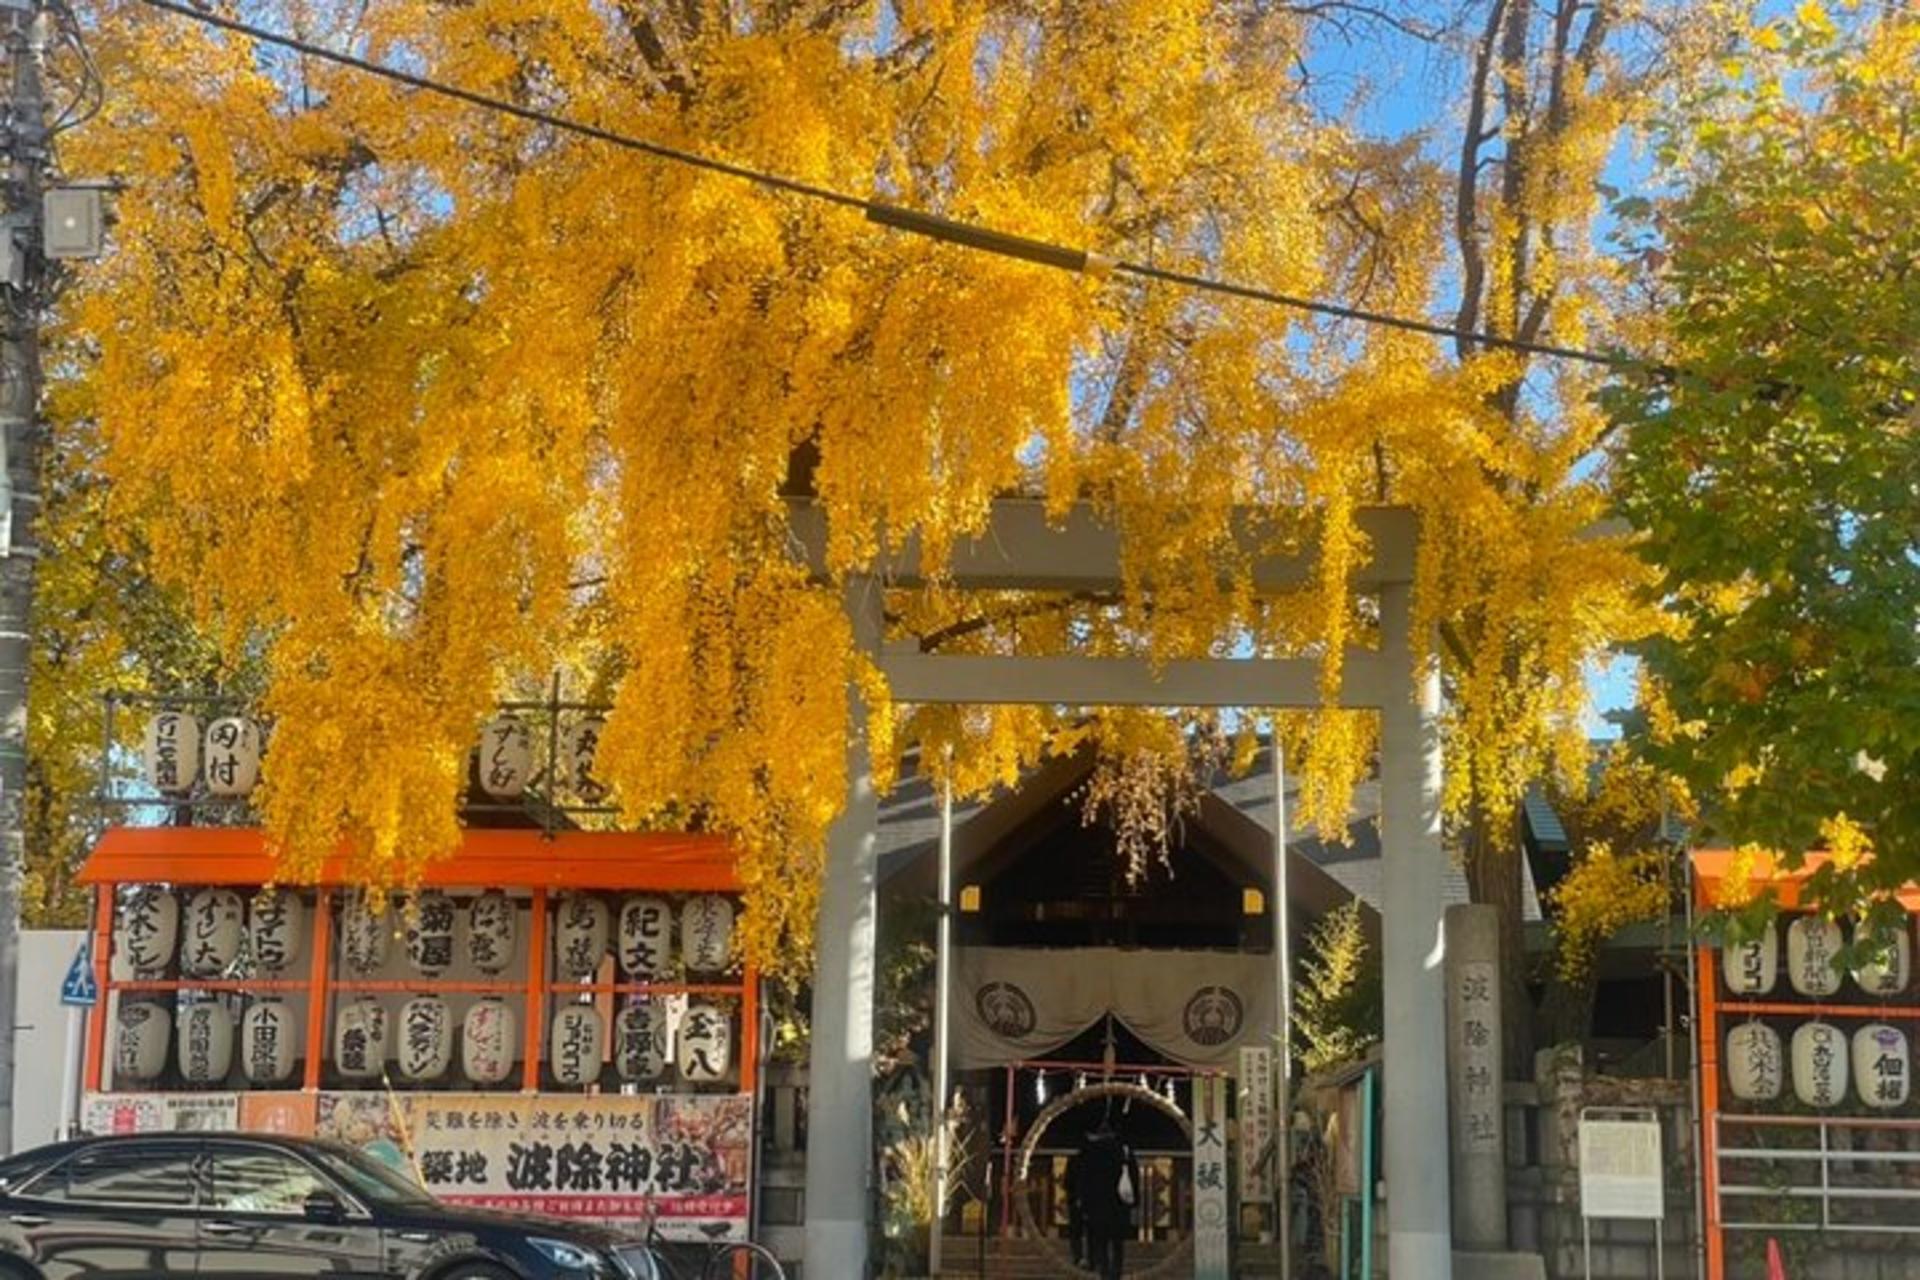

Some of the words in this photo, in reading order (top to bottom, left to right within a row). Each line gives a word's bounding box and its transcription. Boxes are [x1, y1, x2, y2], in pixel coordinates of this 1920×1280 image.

[625, 906, 660, 970] 紀文
[532, 1110, 645, 1131] 波を乗り切る
[422, 1149, 488, 1185] 築地
[506, 1140, 700, 1192] 波除神社
